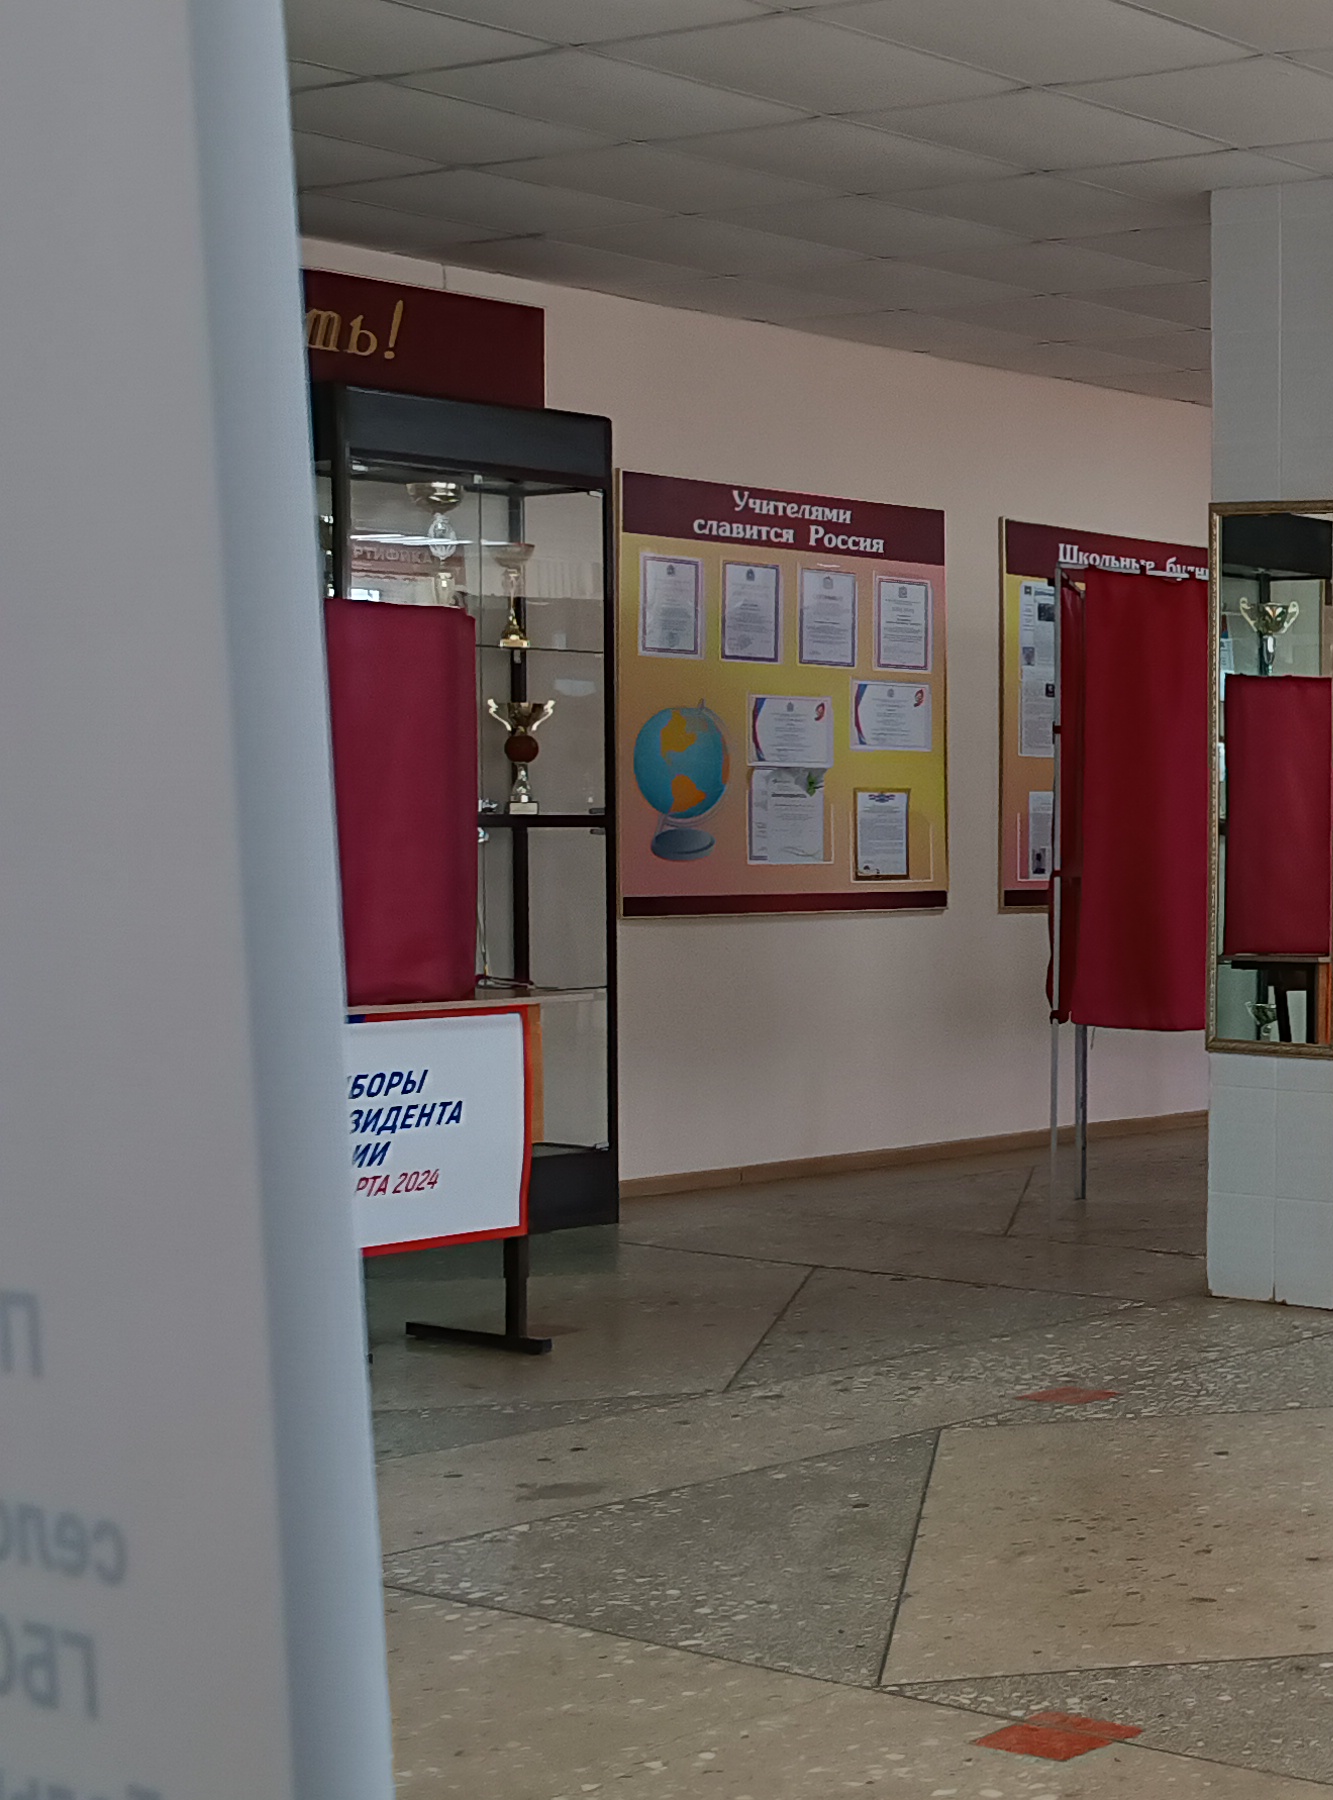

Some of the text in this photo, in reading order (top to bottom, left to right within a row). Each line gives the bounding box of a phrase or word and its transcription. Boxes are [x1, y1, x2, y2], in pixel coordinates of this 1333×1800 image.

[732, 489, 852, 524] Учителями
[693, 518, 885, 553] славится Россия
[347, 1069, 429, 1100] БОРЫ
[349, 1100, 463, 1136] ЗИДЕНТА
[391, 1168, 440, 1194] 2024
